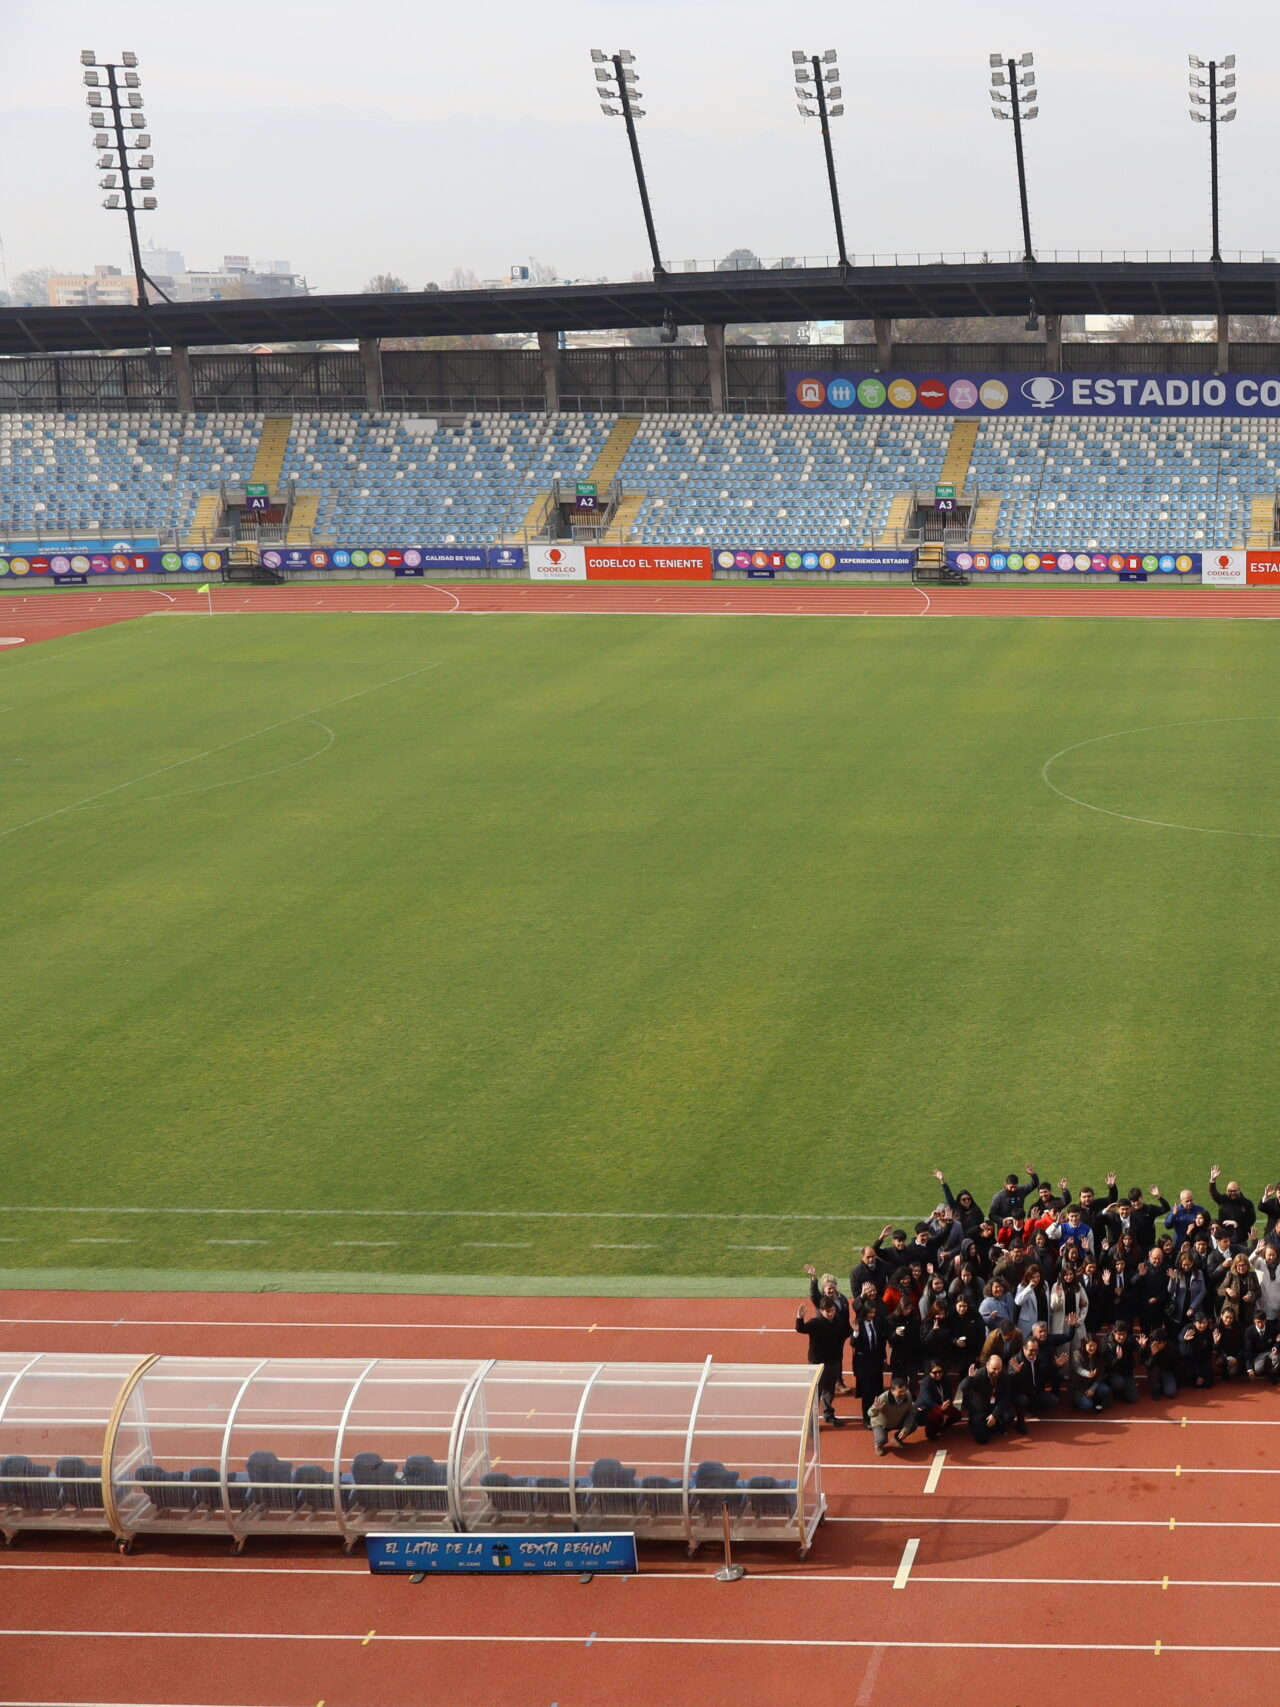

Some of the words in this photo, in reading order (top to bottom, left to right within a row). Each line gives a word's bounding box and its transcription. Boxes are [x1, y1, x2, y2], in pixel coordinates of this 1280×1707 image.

[1072, 379, 1226, 406] ESTADIO
[252, 499, 265, 508] A1
[580, 498, 594, 507] A2
[939, 500, 952, 509] A3
[589, 559, 636, 568] CODELCO
[638, 559, 652, 568] EL
[655, 559, 703, 568] TENIENTE
[385, 1542, 399, 1554] EL
[405, 1541, 439, 1555] LATIR
[445, 1542, 463, 1554] DE
[467, 1542, 483, 1554] LA
[519, 1541, 559, 1555] SEXTA
[563, 1540, 612, 1556] REGIÓN
